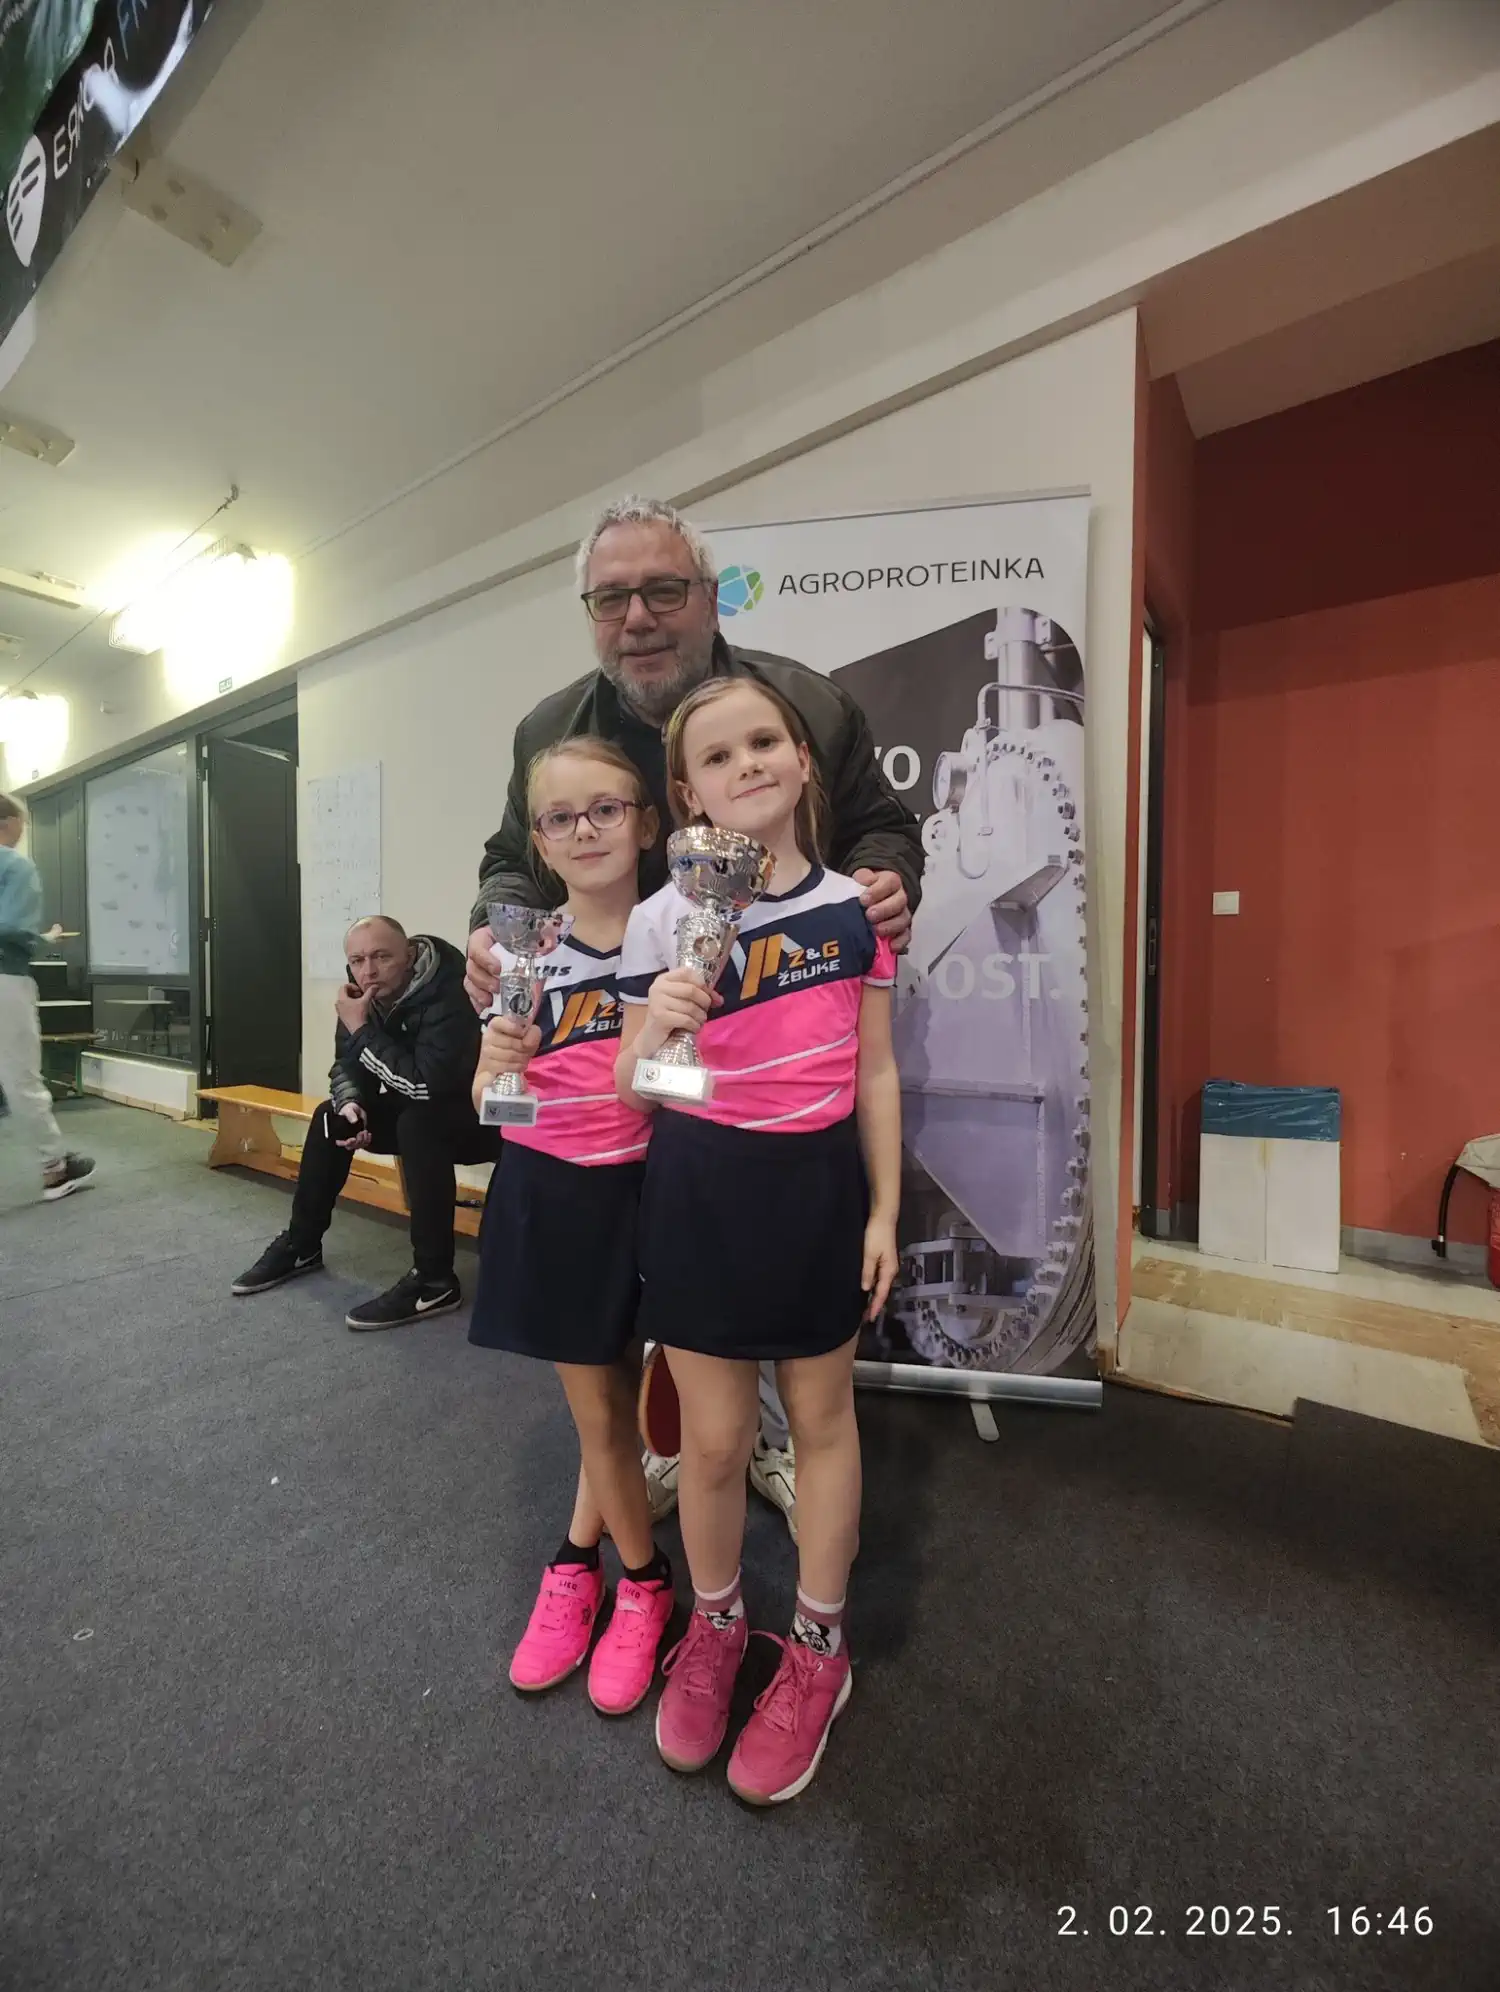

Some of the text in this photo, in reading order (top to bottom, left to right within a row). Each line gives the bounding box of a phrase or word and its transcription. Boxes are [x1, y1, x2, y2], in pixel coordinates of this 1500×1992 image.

[778, 557, 1045, 596] AGROPROTEINKA
[873, 744, 921, 791] O
[777, 959, 841, 987] ŽBUKE
[584, 1018, 623, 1034] ŽBU
